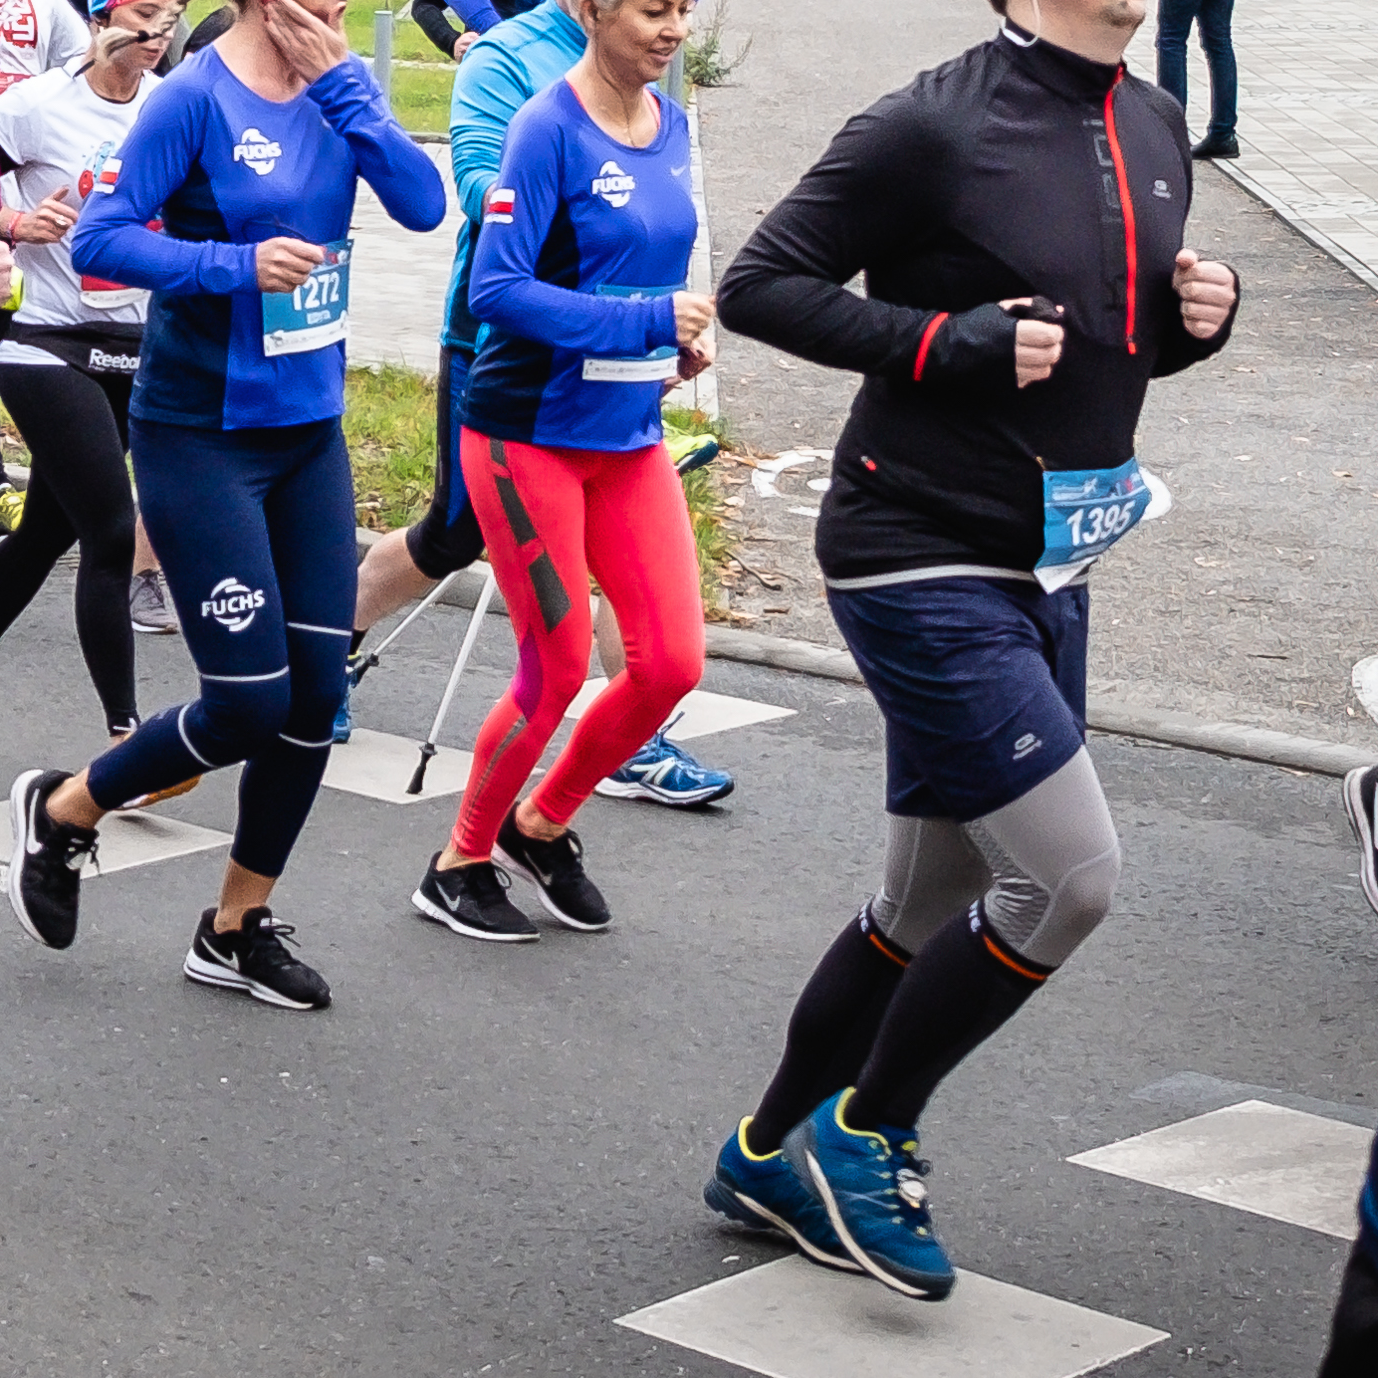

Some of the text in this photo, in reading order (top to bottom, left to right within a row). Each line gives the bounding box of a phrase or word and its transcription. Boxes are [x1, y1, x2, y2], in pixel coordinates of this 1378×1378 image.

[293, 272, 340, 311] 1272
[1066, 501, 1136, 546] 1395
[201, 589, 265, 617] FUCHS
